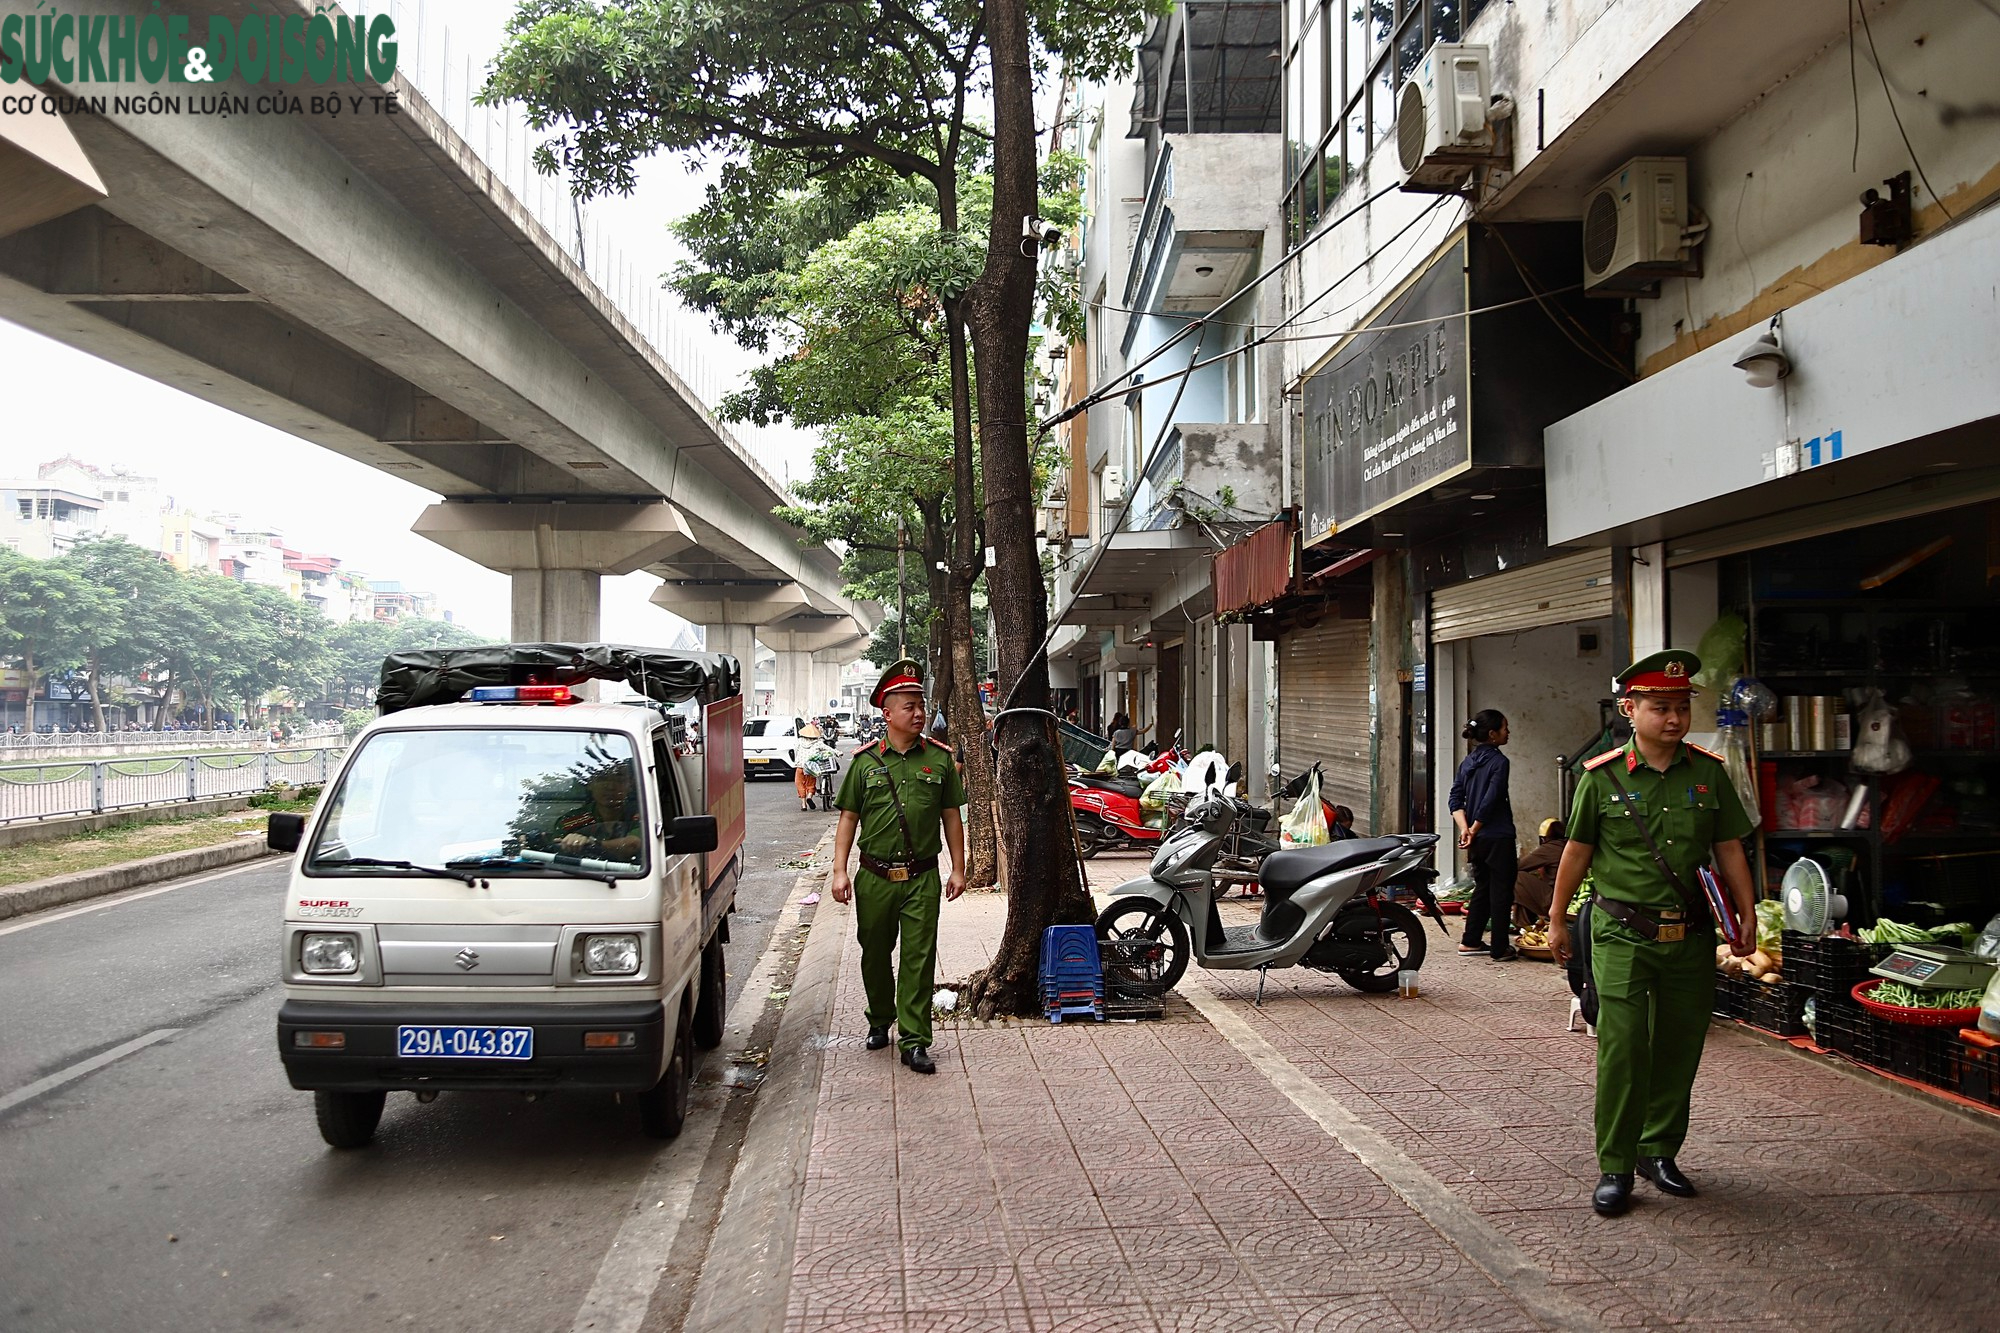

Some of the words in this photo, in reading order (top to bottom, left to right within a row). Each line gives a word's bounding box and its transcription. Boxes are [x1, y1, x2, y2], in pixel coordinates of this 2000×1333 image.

[1383, 320, 1447, 416] APPLE
[1804, 430, 1843, 466] 11
[297, 907, 364, 918] CARRY
[402, 1029, 529, 1056] 29A-043.87
